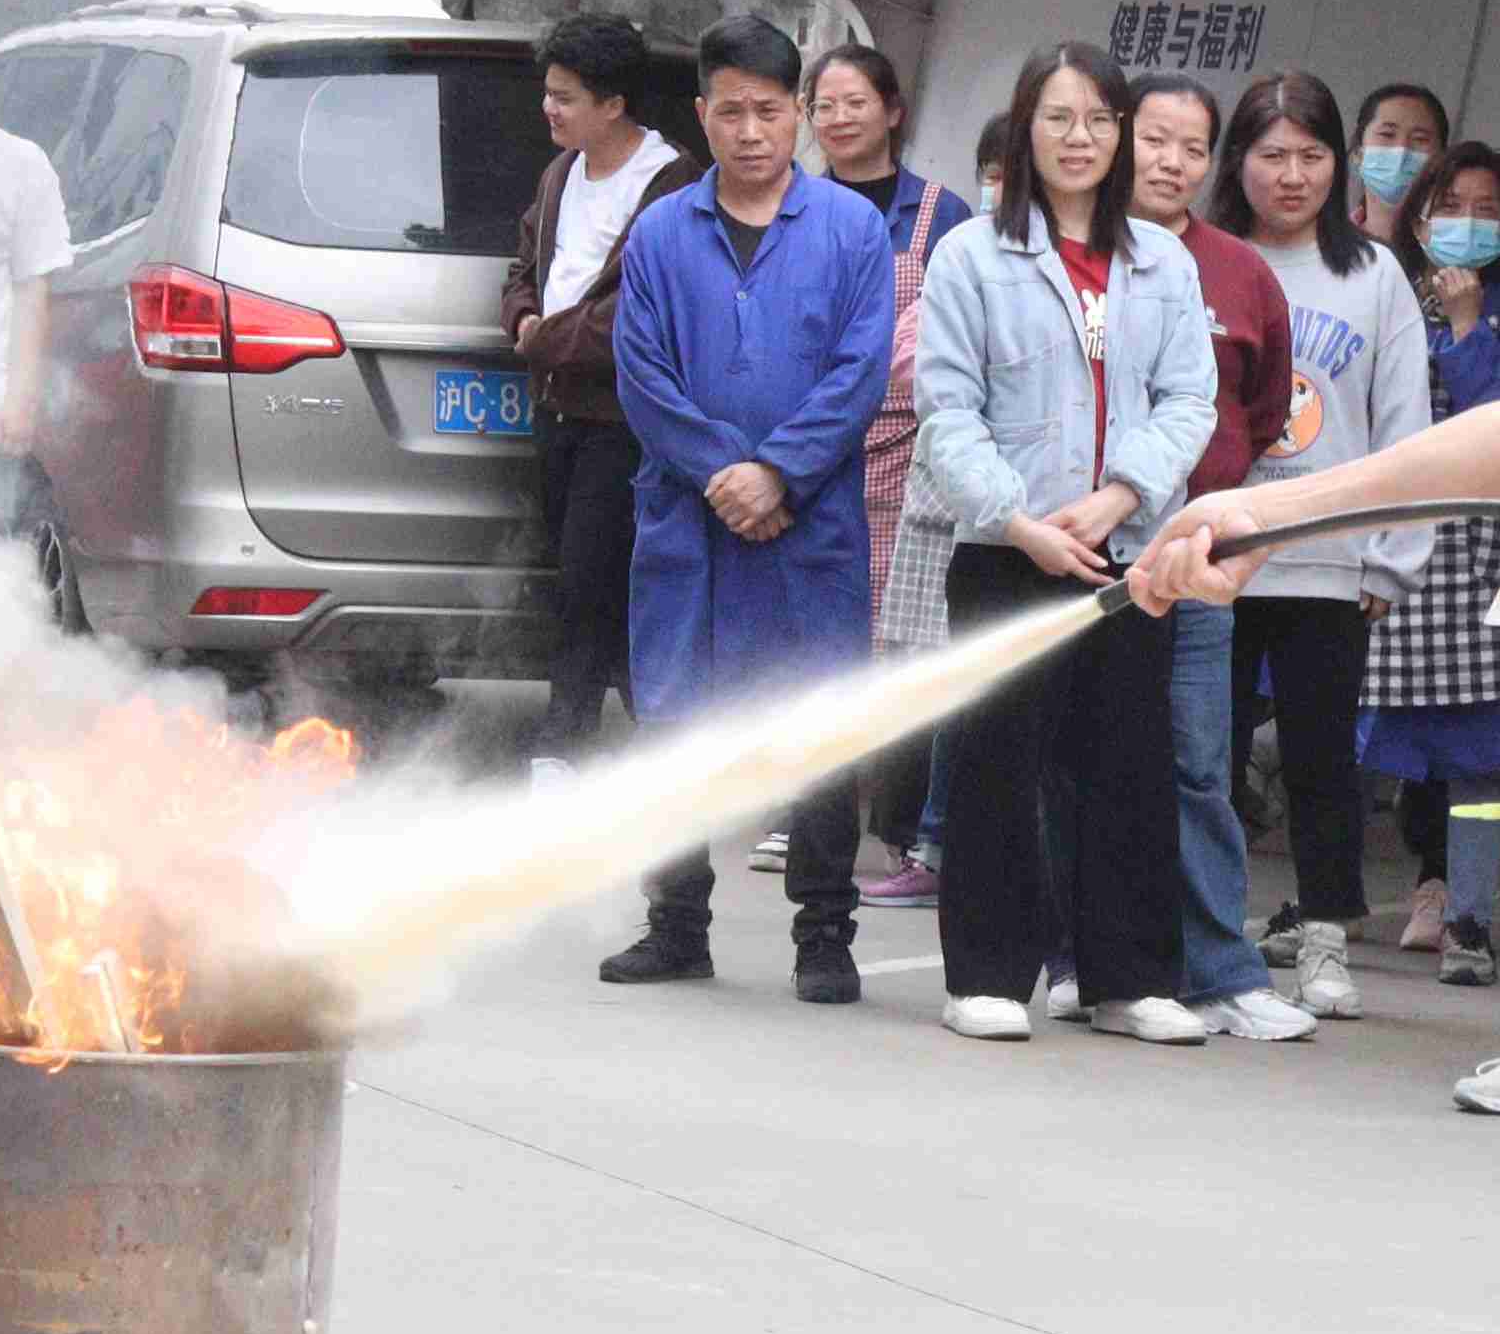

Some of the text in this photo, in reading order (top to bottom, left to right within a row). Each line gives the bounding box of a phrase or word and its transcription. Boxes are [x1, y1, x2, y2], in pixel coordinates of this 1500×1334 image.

[1109, 1, 1266, 72] 健康与福利
[439, 379, 533, 425] 沪C·8
